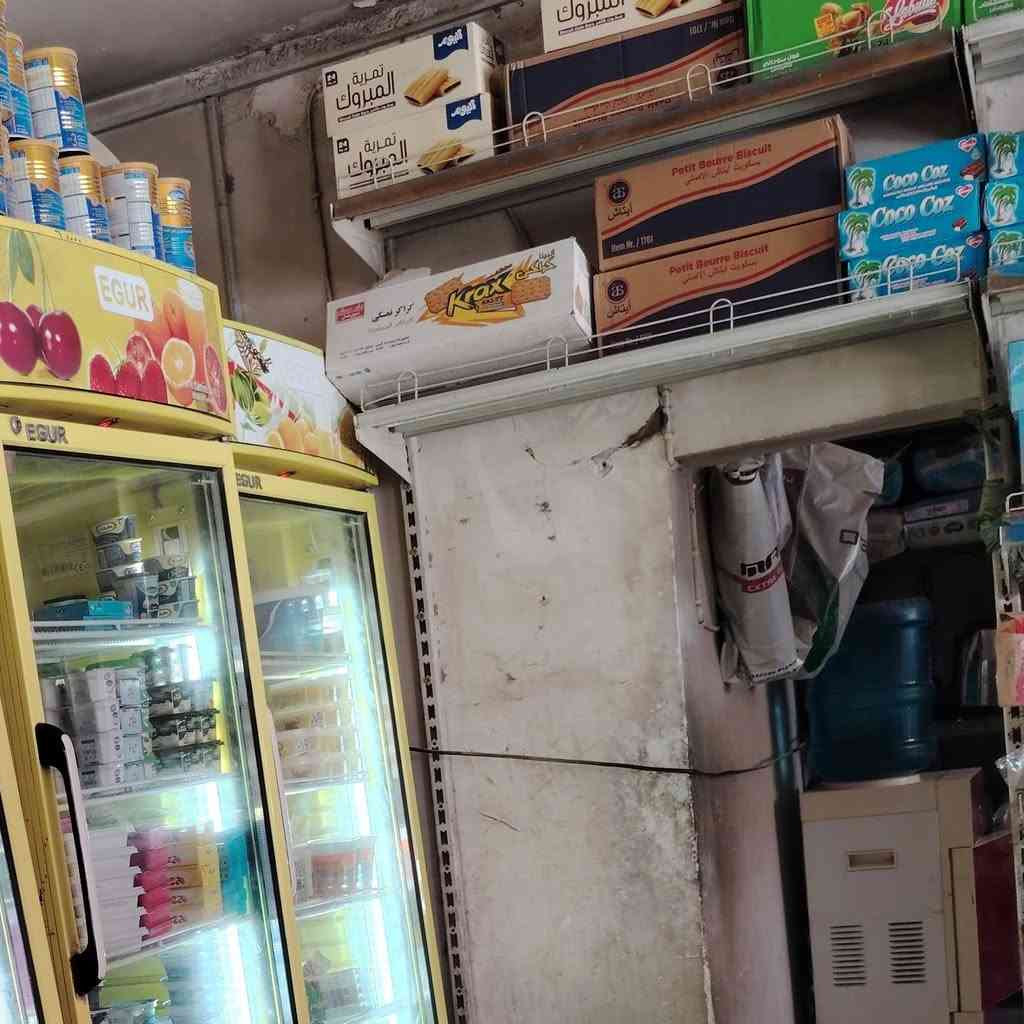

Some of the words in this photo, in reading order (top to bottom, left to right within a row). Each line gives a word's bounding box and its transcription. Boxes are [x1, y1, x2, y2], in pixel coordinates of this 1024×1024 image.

[336, 69, 395, 110] المبروك
[671, 164, 695, 177] Petit
[736, 144, 772, 161] Biscuit
[882, 171, 918, 192] Coco
[871, 204, 915, 226] Coco
[670, 263, 694, 276] Petit
[733, 244, 769, 261] Biscuit
[97, 273, 150, 313] EGUR
[447, 269, 513, 317] Krax
[25, 423, 68, 444] EGUR
